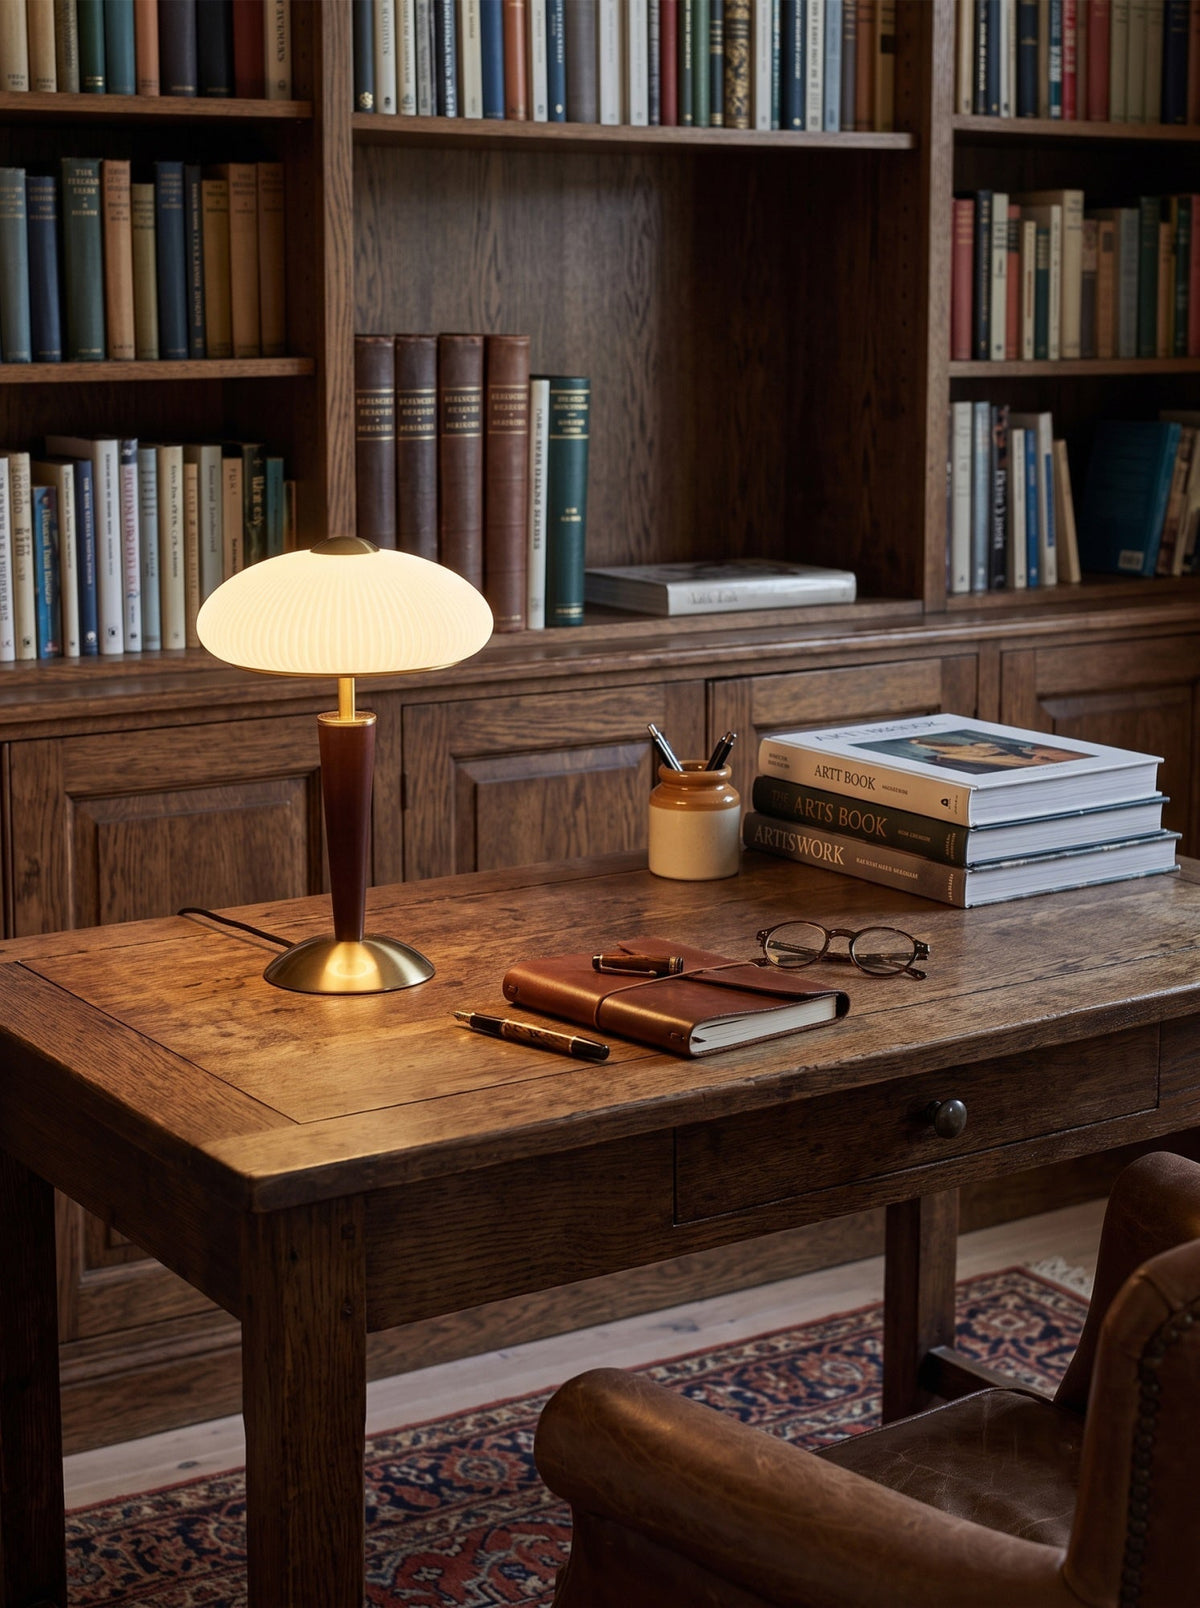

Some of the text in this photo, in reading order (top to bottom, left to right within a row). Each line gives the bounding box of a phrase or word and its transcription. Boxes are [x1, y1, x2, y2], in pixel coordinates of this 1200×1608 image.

[814, 764, 843, 782] ARTT
[844, 771, 876, 791] BOOK
[793, 797, 834, 823] ARTS
[839, 807, 888, 838] BOOK
